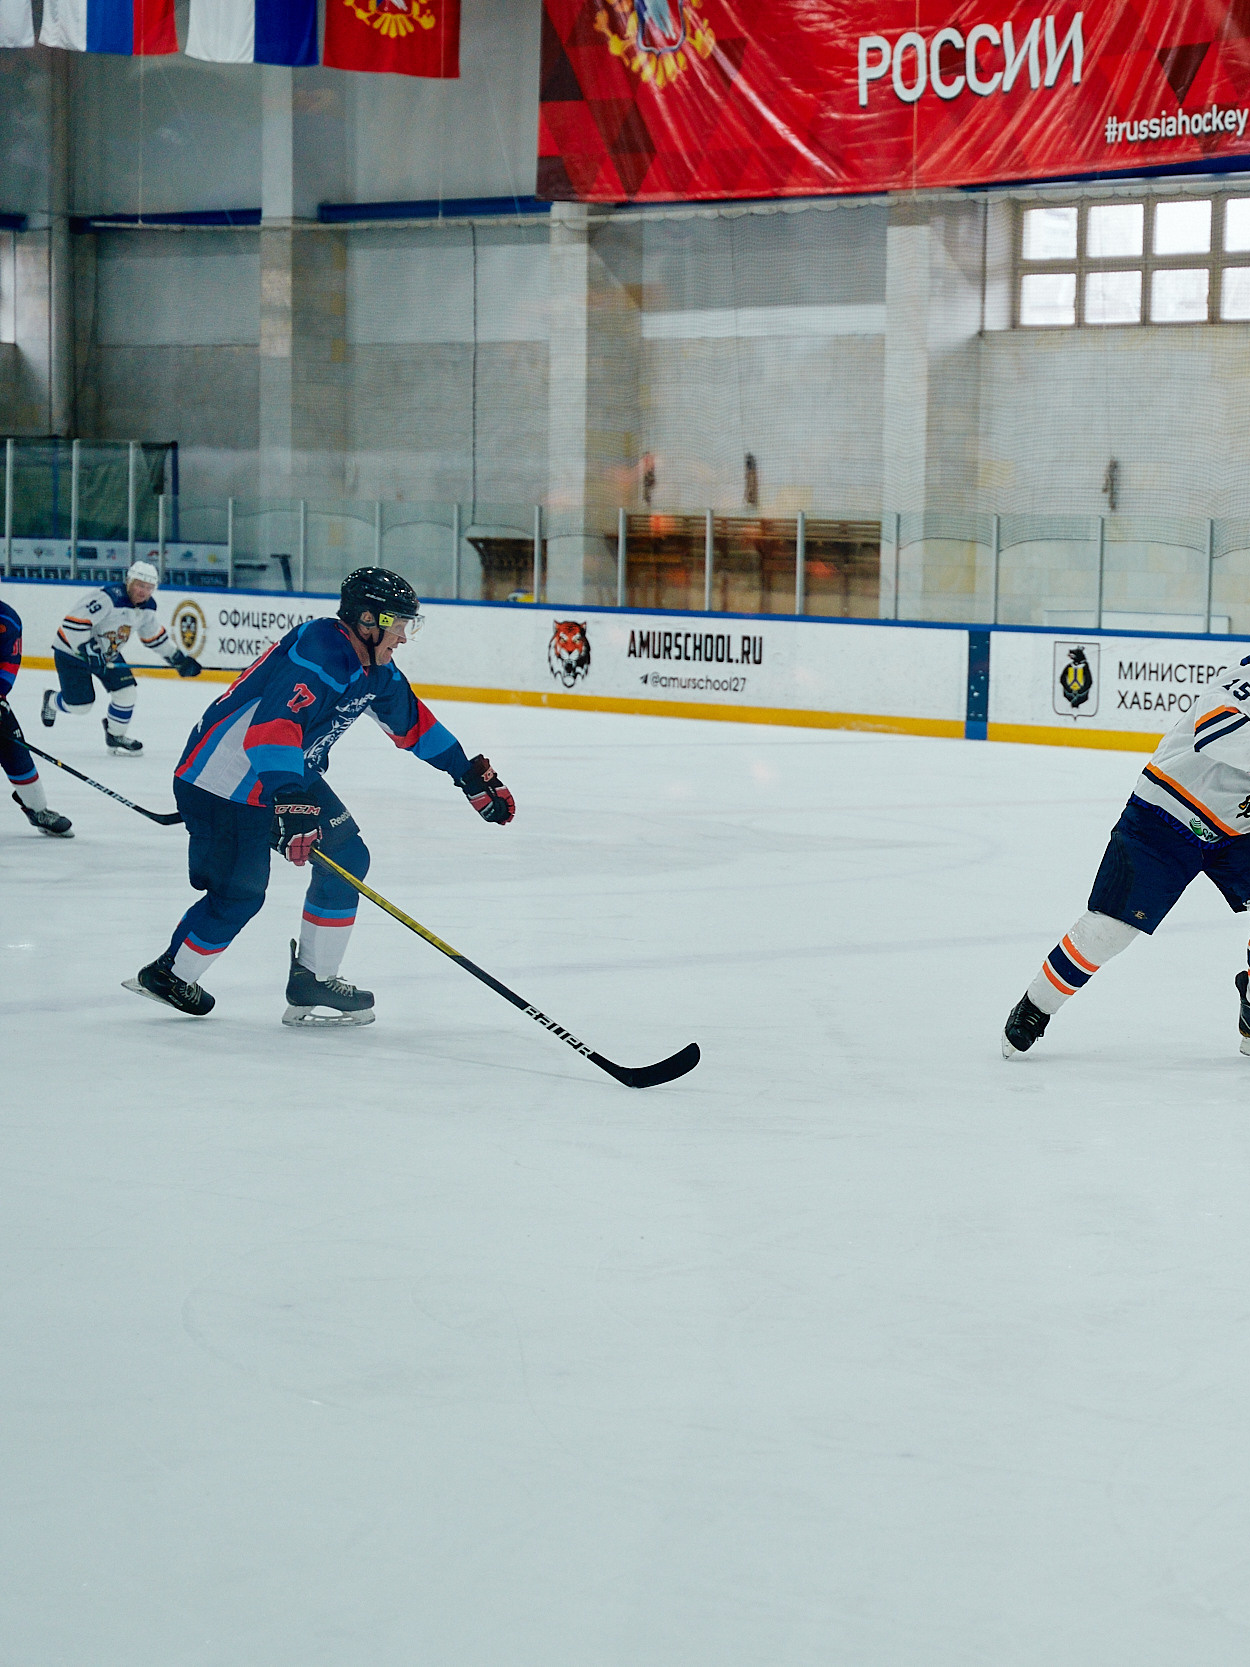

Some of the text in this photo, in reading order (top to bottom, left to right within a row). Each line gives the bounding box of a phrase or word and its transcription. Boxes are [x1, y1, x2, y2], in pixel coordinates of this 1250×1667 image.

[858, 11, 1085, 107] РОССИИ
[1105, 104, 1250, 144] #russiahockey
[218, 637, 275, 656] ХОККЕ
[627, 629, 763, 665] AMURSCHOOL.RU
[651, 671, 747, 692] @amurschool27
[1117, 689, 1200, 713] ХАБАРО
[522, 1005, 595, 1058] BAUER
